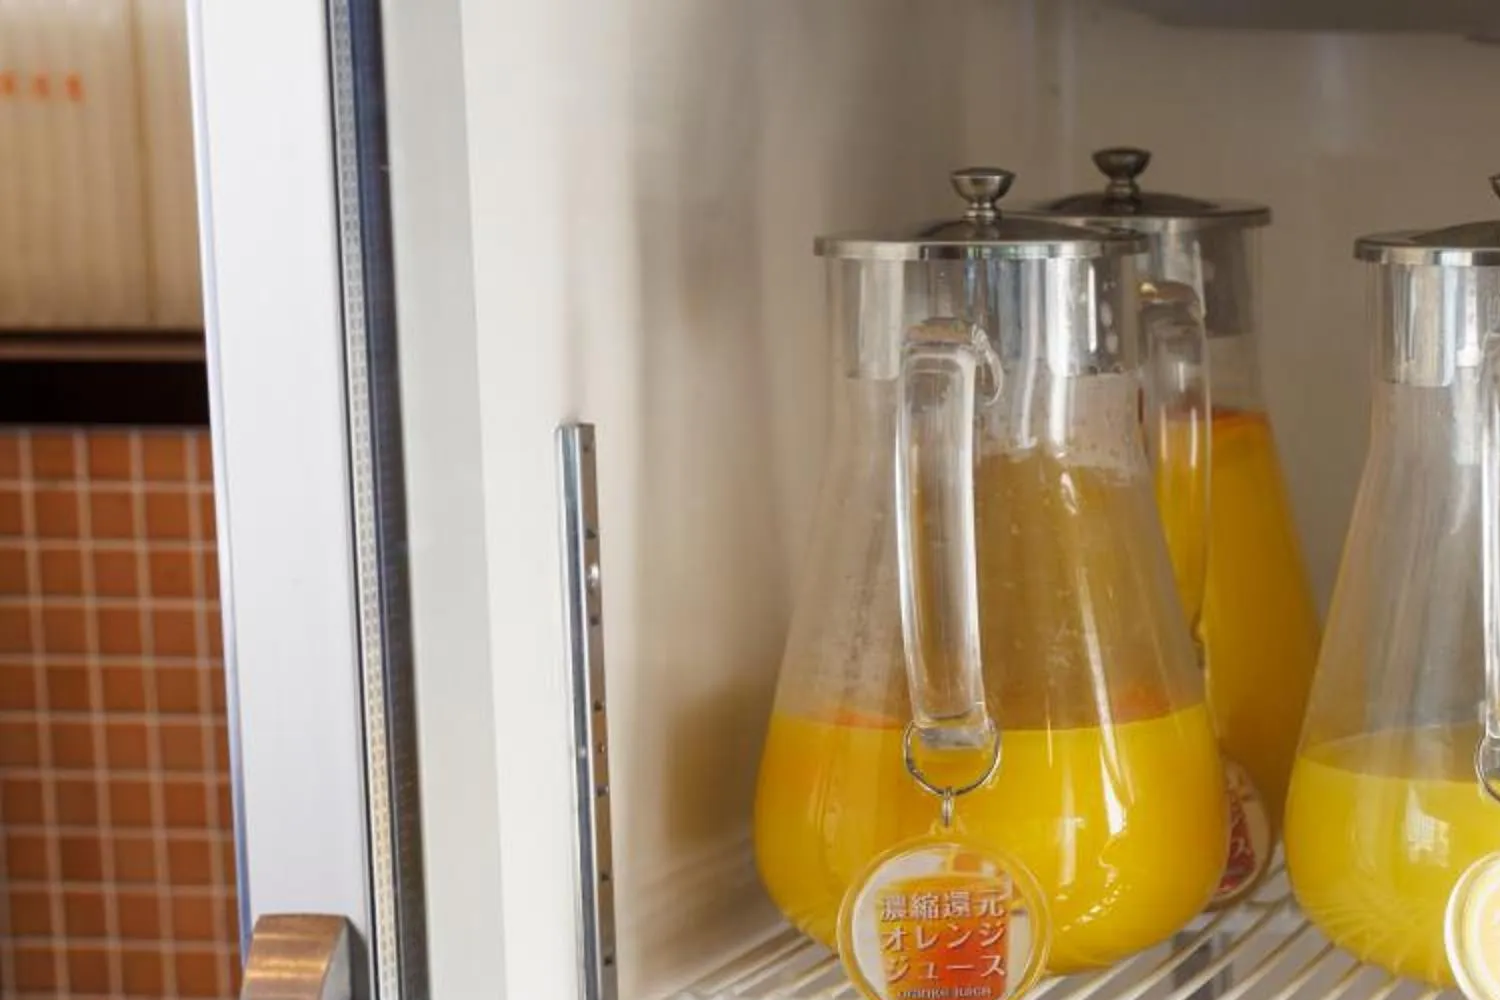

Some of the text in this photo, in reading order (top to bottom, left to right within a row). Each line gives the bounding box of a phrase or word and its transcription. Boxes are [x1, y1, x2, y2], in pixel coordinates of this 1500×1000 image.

[881, 921, 1006, 951] オレンジ
[885, 954, 1006, 983] ジュース
